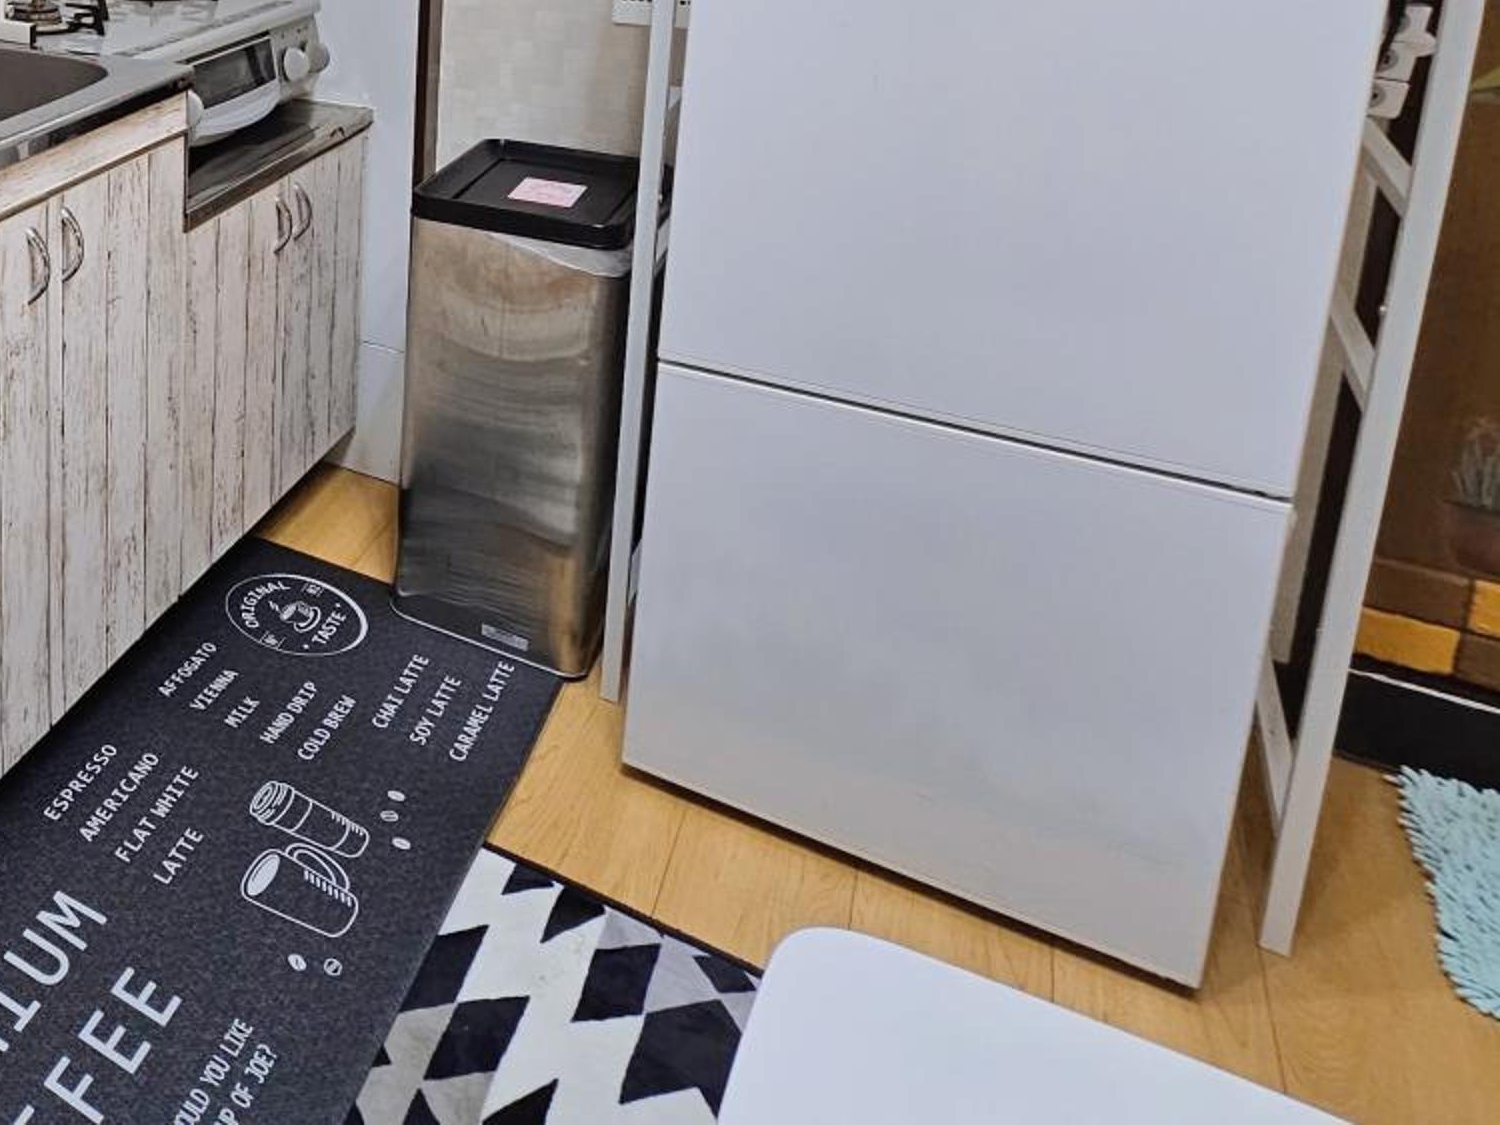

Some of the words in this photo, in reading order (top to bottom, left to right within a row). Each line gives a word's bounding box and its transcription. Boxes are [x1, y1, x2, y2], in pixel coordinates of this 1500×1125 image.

[240, 580, 291, 629] ORIGINAL
[311, 608, 347, 644] TASTE
[158, 641, 217, 697] AFFOGATO
[189, 669, 239, 710] VIENNA
[371, 693, 405, 728] CHAI
[393, 653, 430, 695] LATTE
[223, 695, 261, 728] MILK
[259, 711, 295, 744] HAND
[286, 680, 317, 714] DRIP
[297, 727, 331, 760] COLD
[322, 694, 357, 730] BREW
[409, 716, 437, 746] SOY
[425, 674, 462, 718] LATTE
[448, 703, 494, 762] CARAMEL
[481, 660, 515, 703] LATTE
[43, 743, 118, 821] ESPRESSO
[79, 752, 160, 843] AMERICANO
[113, 816, 157, 863] FLAT
[149, 765, 200, 819] WHITE
[152, 827, 205, 885] LATTE
[12, 966, 183, 1125] FEE
[199, 1054, 232, 1087] YOU
[219, 1017, 255, 1058] LIKE
[230, 1082, 256, 1109] OF
[244, 1043, 279, 1084] JOE?
